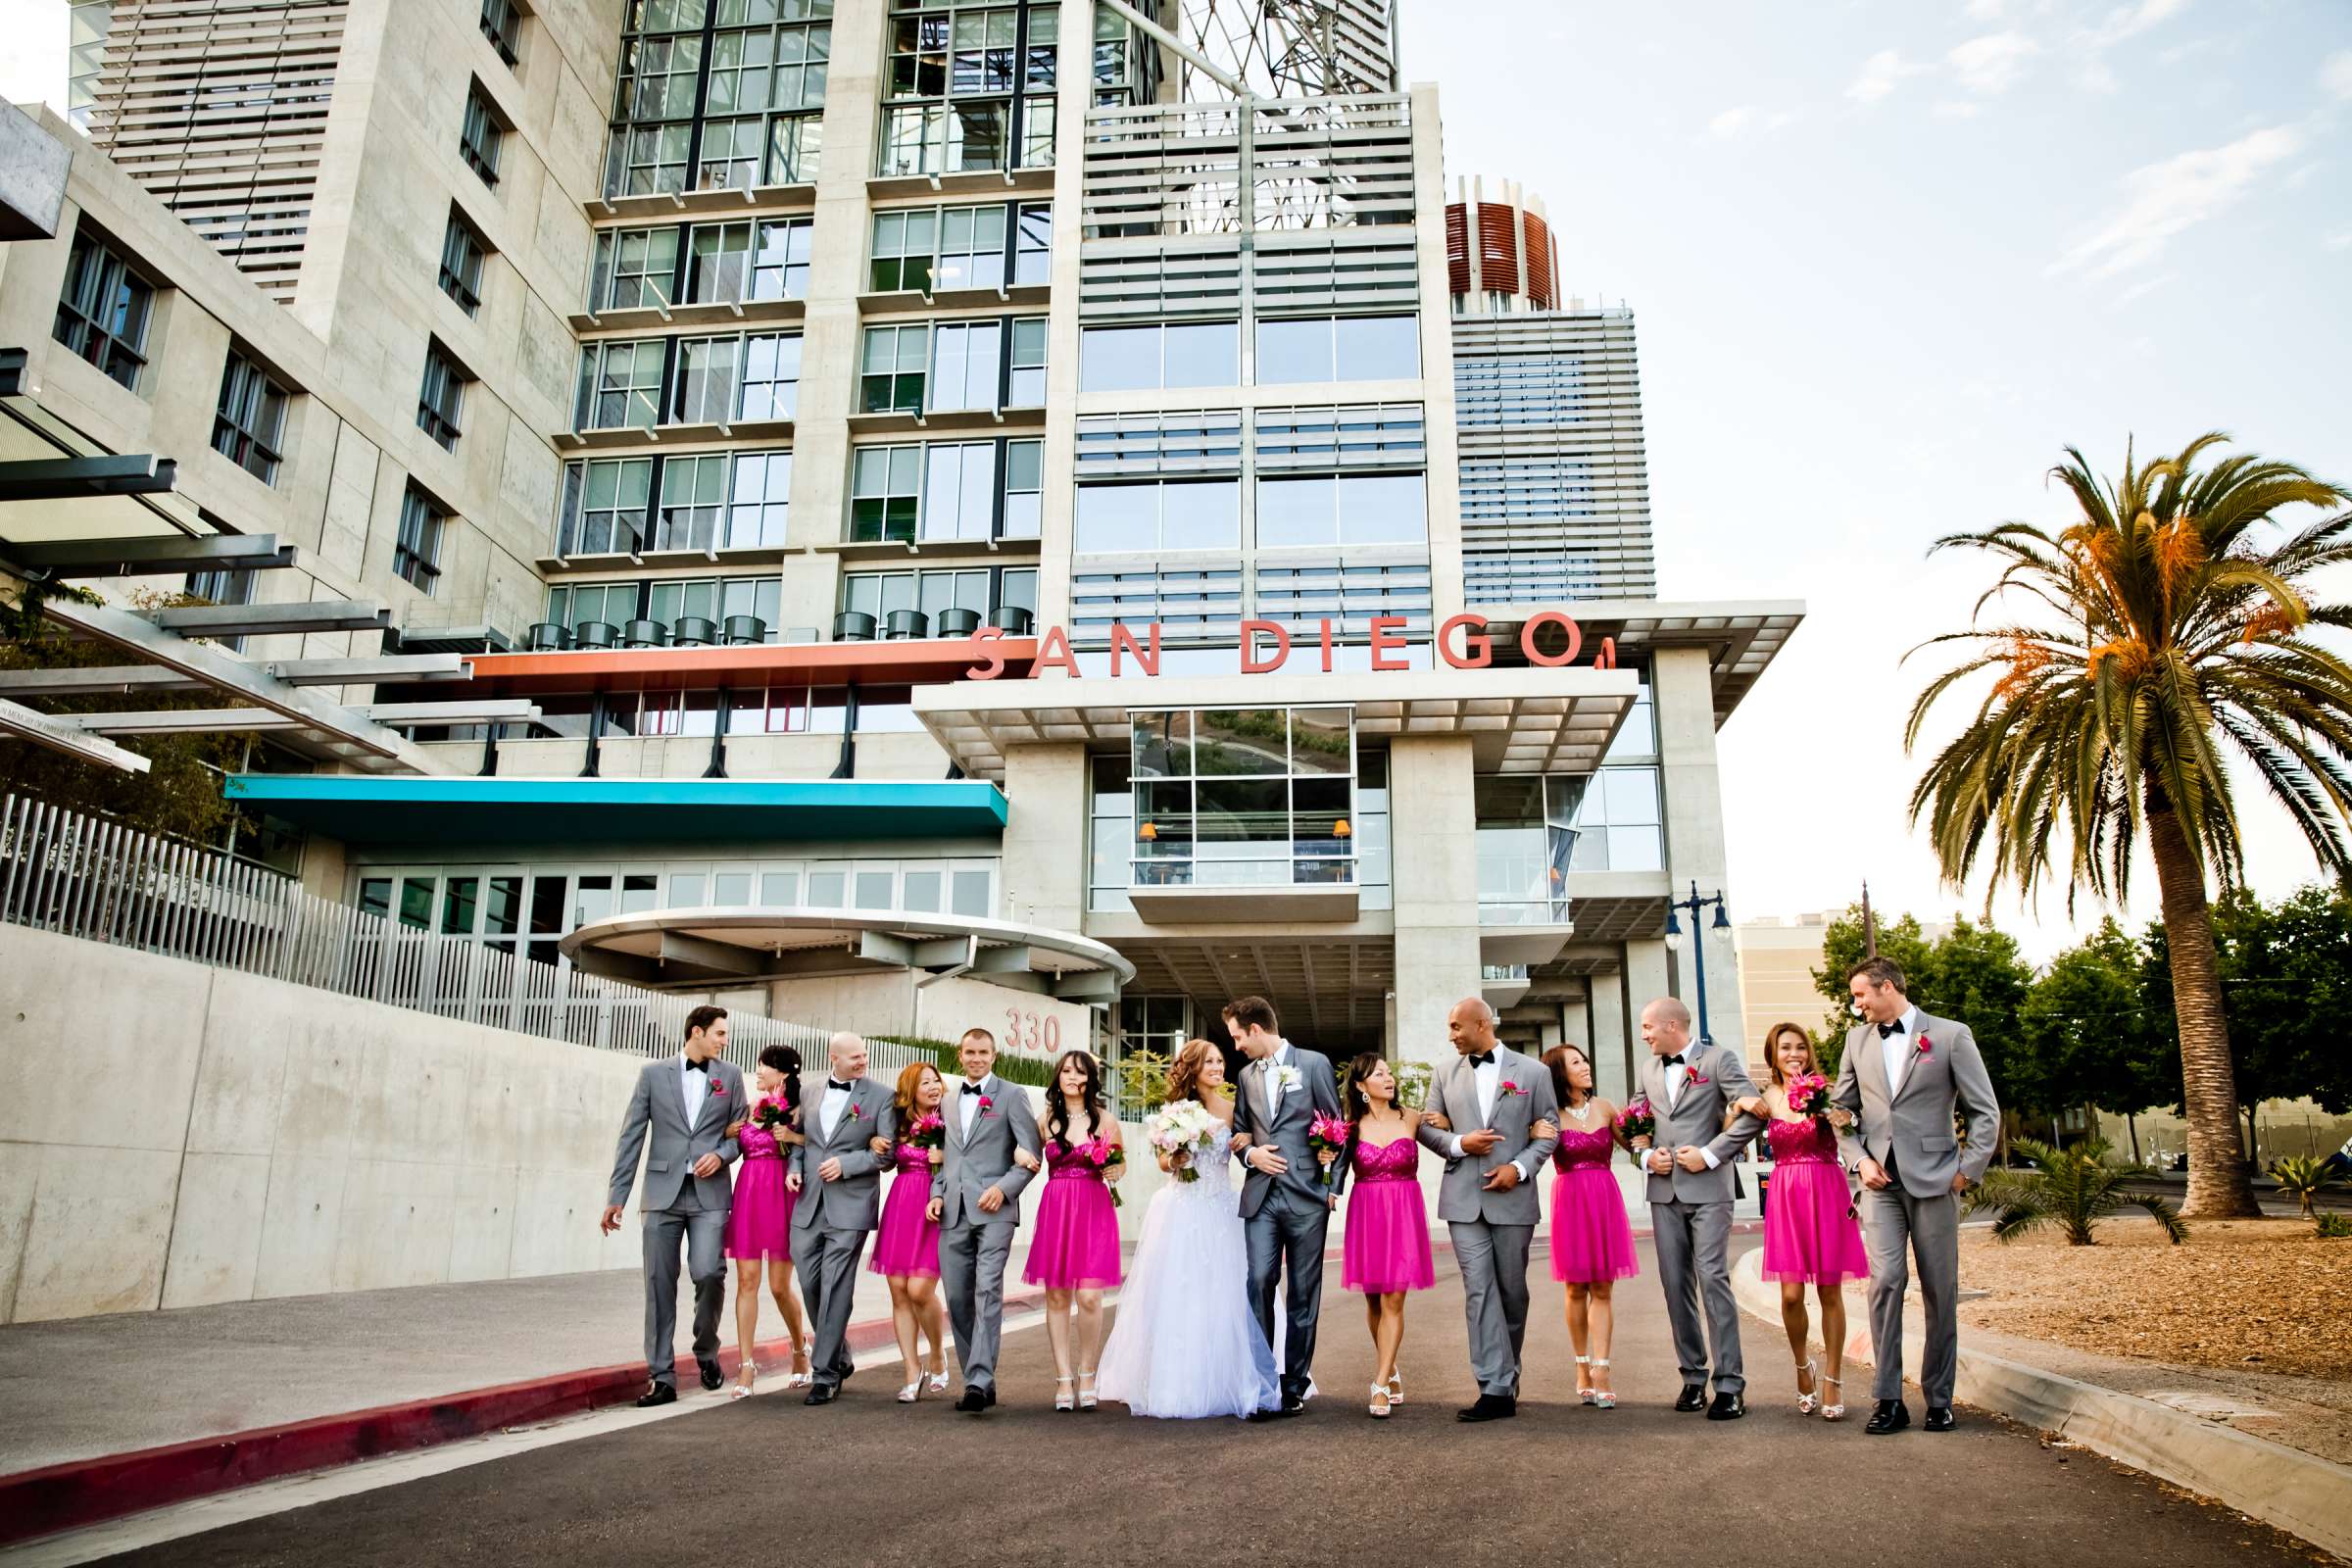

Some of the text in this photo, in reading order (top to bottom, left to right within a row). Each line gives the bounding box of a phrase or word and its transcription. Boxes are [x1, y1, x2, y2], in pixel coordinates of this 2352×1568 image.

[965, 623, 1160, 681] SAN
[1241, 611, 1582, 674] DIEGO
[1004, 1006, 1060, 1054] 330
